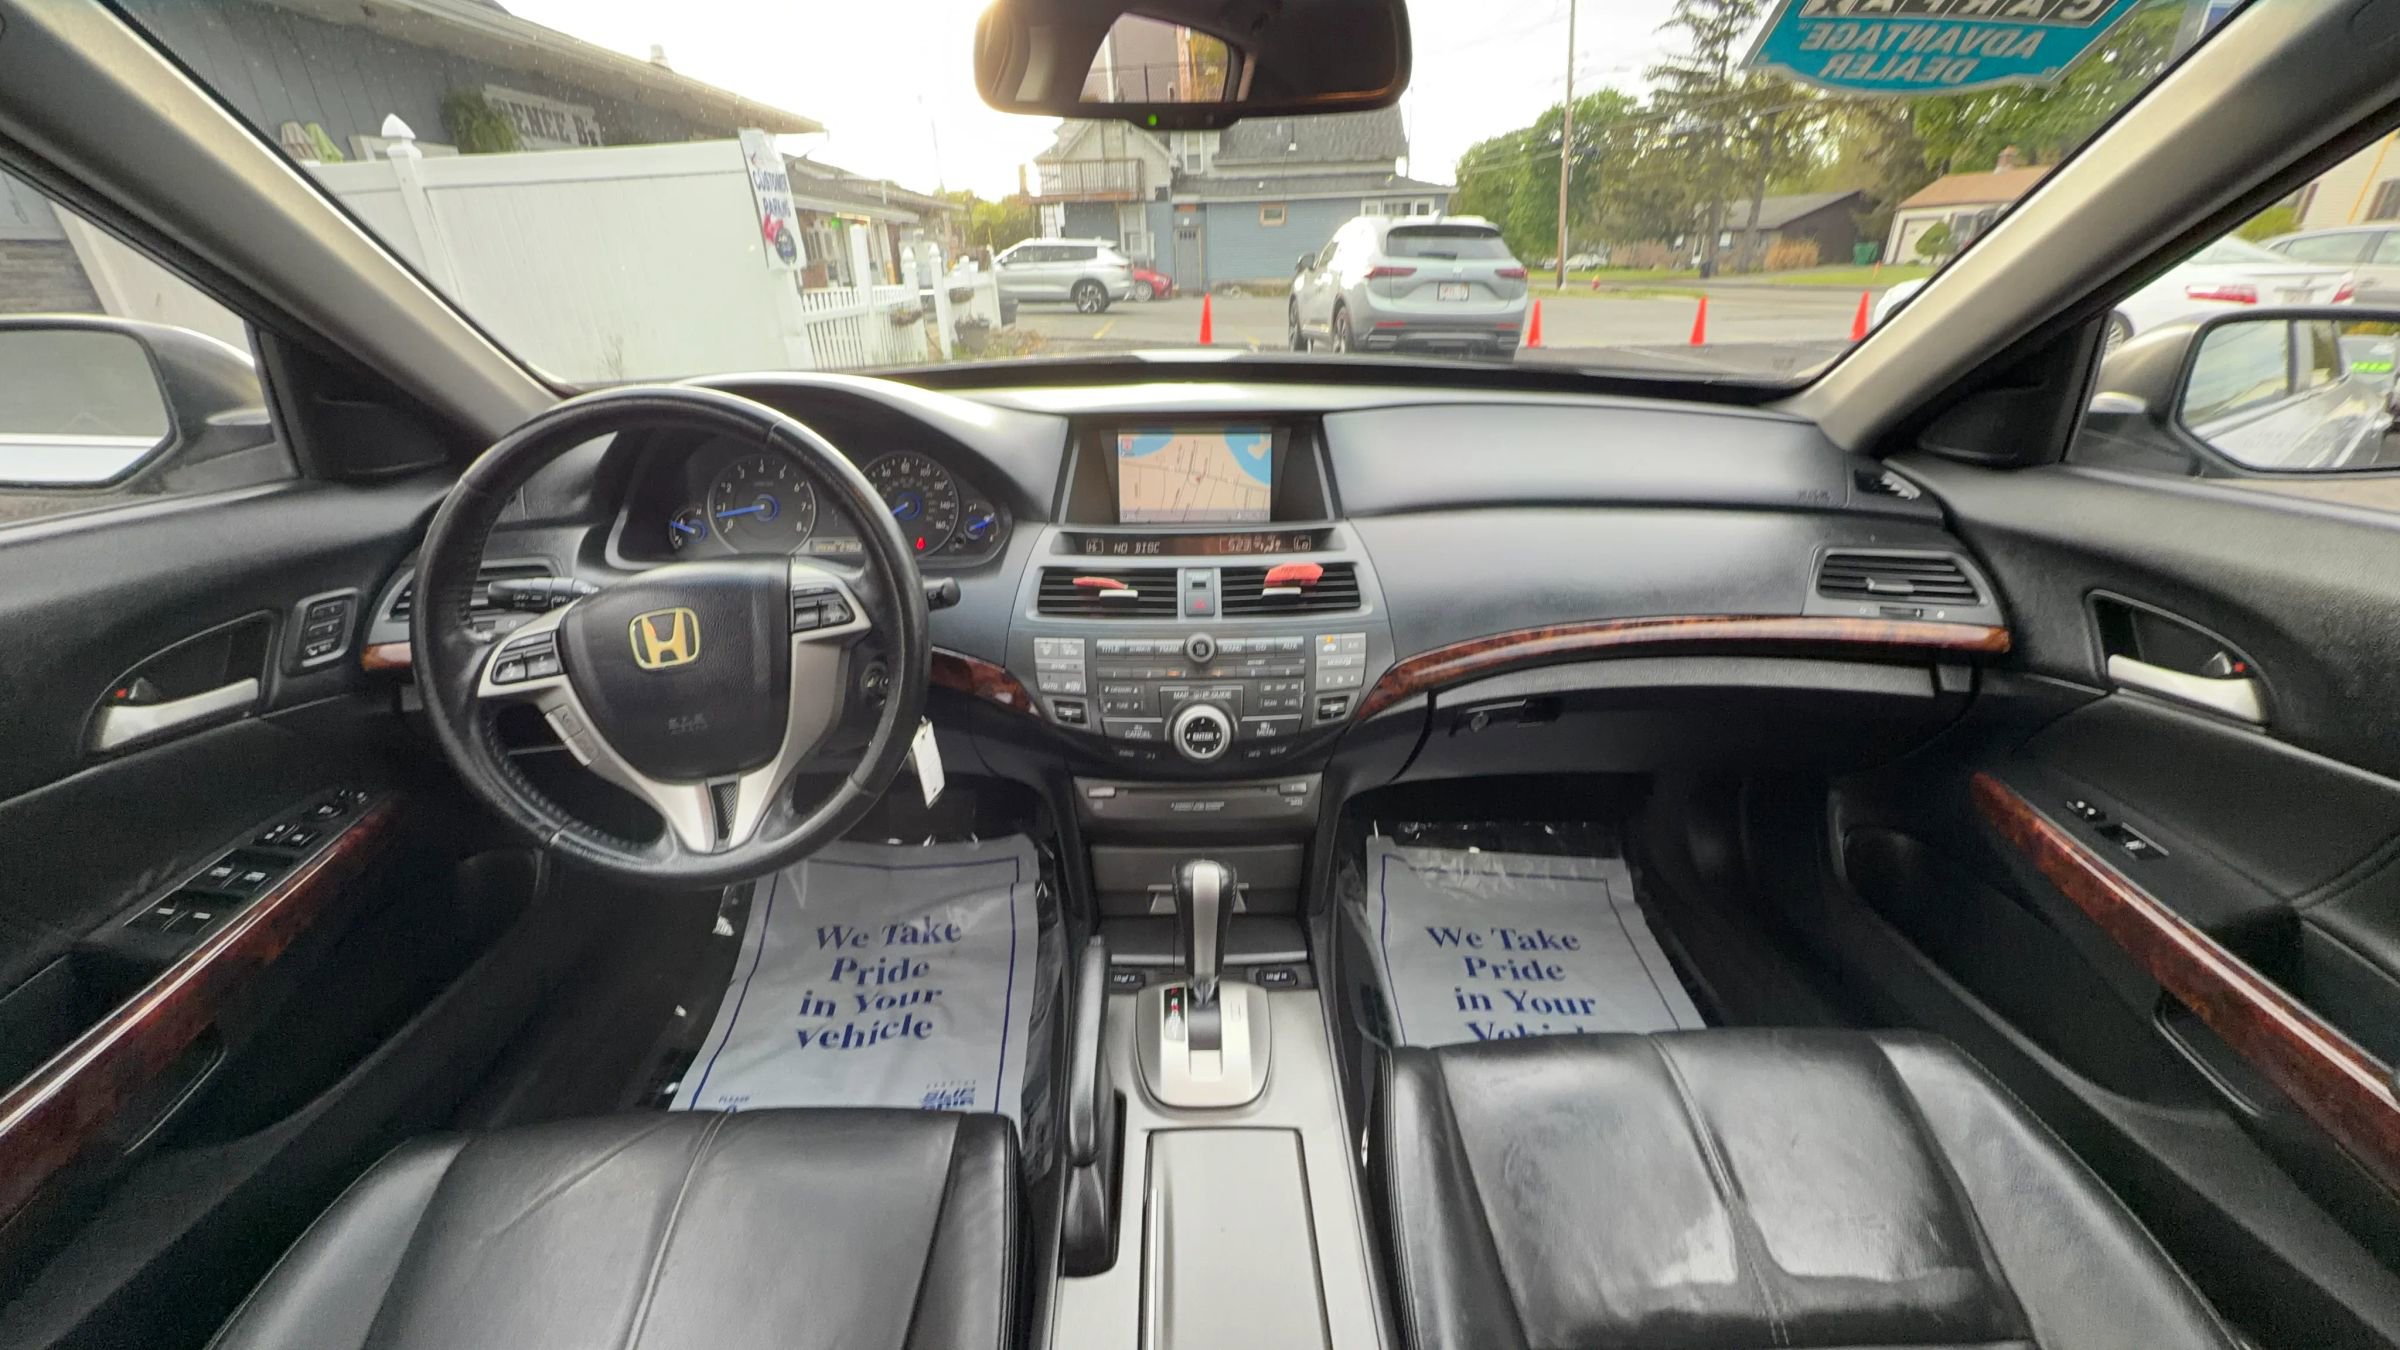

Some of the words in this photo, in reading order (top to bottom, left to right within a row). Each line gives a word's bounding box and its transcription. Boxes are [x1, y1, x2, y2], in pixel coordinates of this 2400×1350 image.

[816, 925, 870, 950] We
[881, 915, 962, 947] Take
[1425, 926, 1484, 949] We
[1491, 926, 1581, 951] Take
[829, 957, 931, 985] Pride
[1462, 954, 1566, 982] Pride
[798, 989, 836, 1017] in
[854, 989, 943, 1014] Your
[1454, 986, 1493, 1011] in
[1501, 988, 1597, 1016] Your
